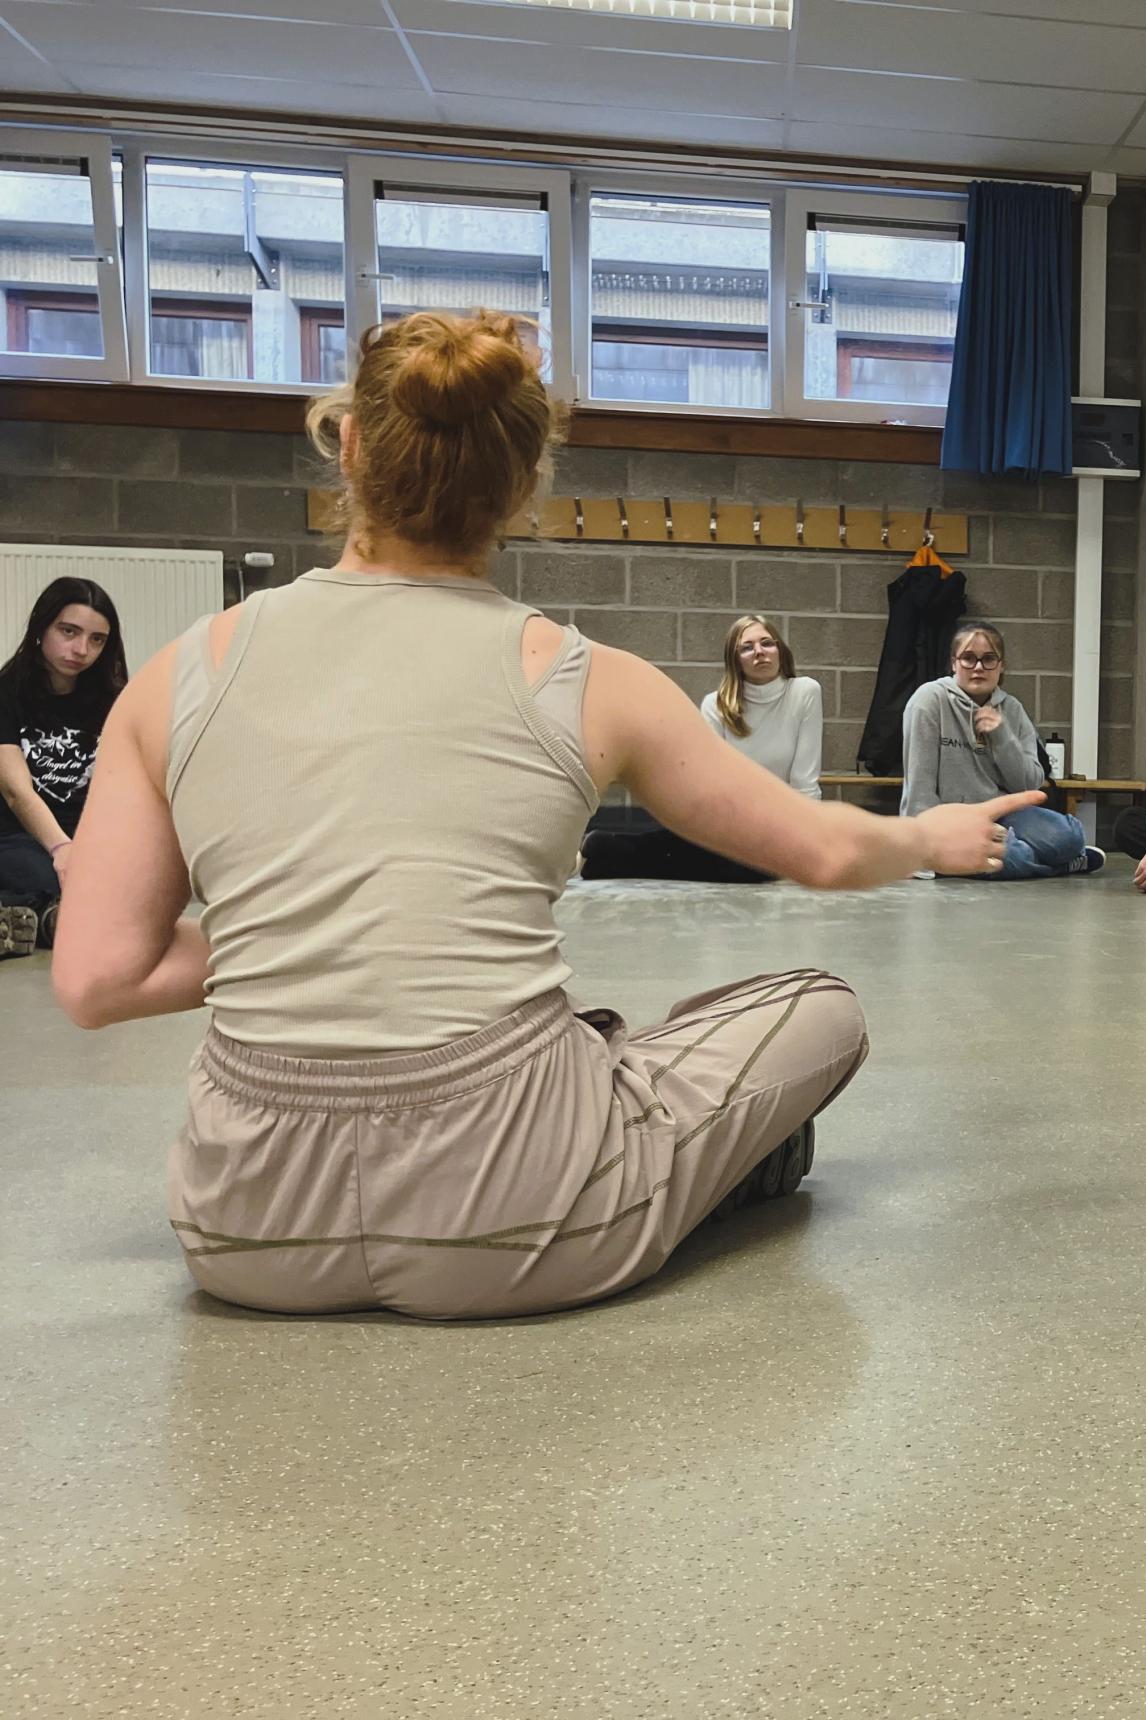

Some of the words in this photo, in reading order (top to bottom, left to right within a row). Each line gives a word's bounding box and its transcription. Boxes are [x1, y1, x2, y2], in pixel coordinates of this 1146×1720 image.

[36, 755, 72, 772] Angel
[70, 760, 82, 769] in
[41, 770, 79, 785] disguise
